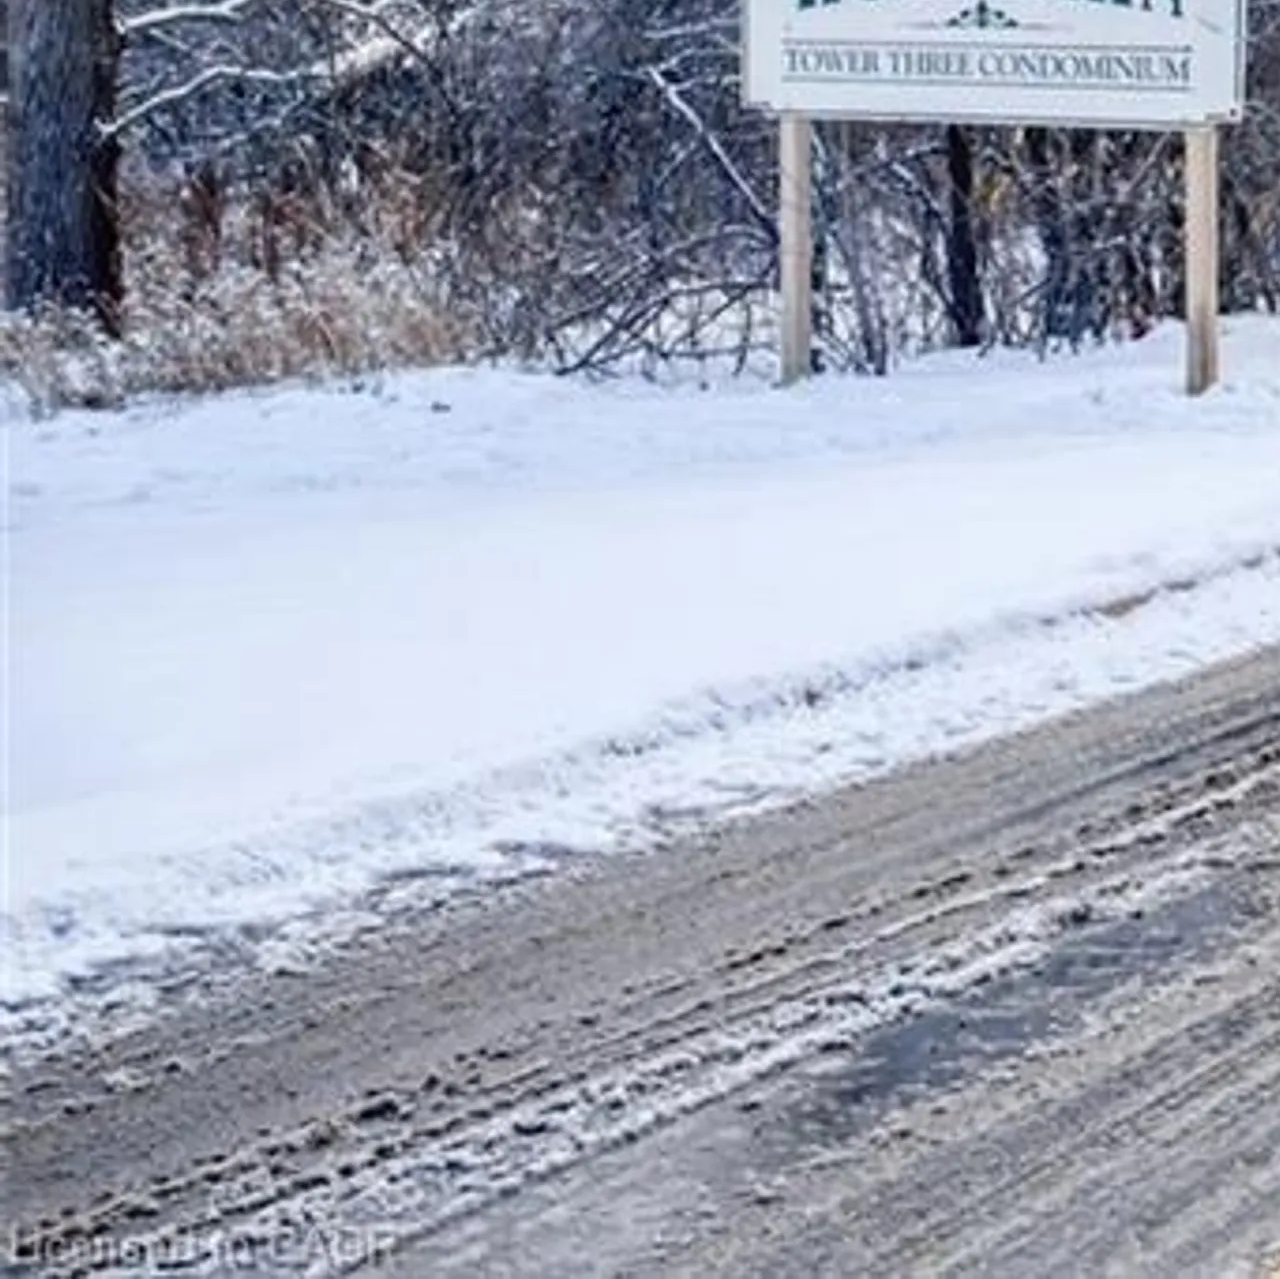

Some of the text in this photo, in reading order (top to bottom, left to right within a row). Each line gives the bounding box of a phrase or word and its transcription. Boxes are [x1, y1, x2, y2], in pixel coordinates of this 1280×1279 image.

[786, 49, 1191, 84] TOWER THREE CONDOMINIUM
